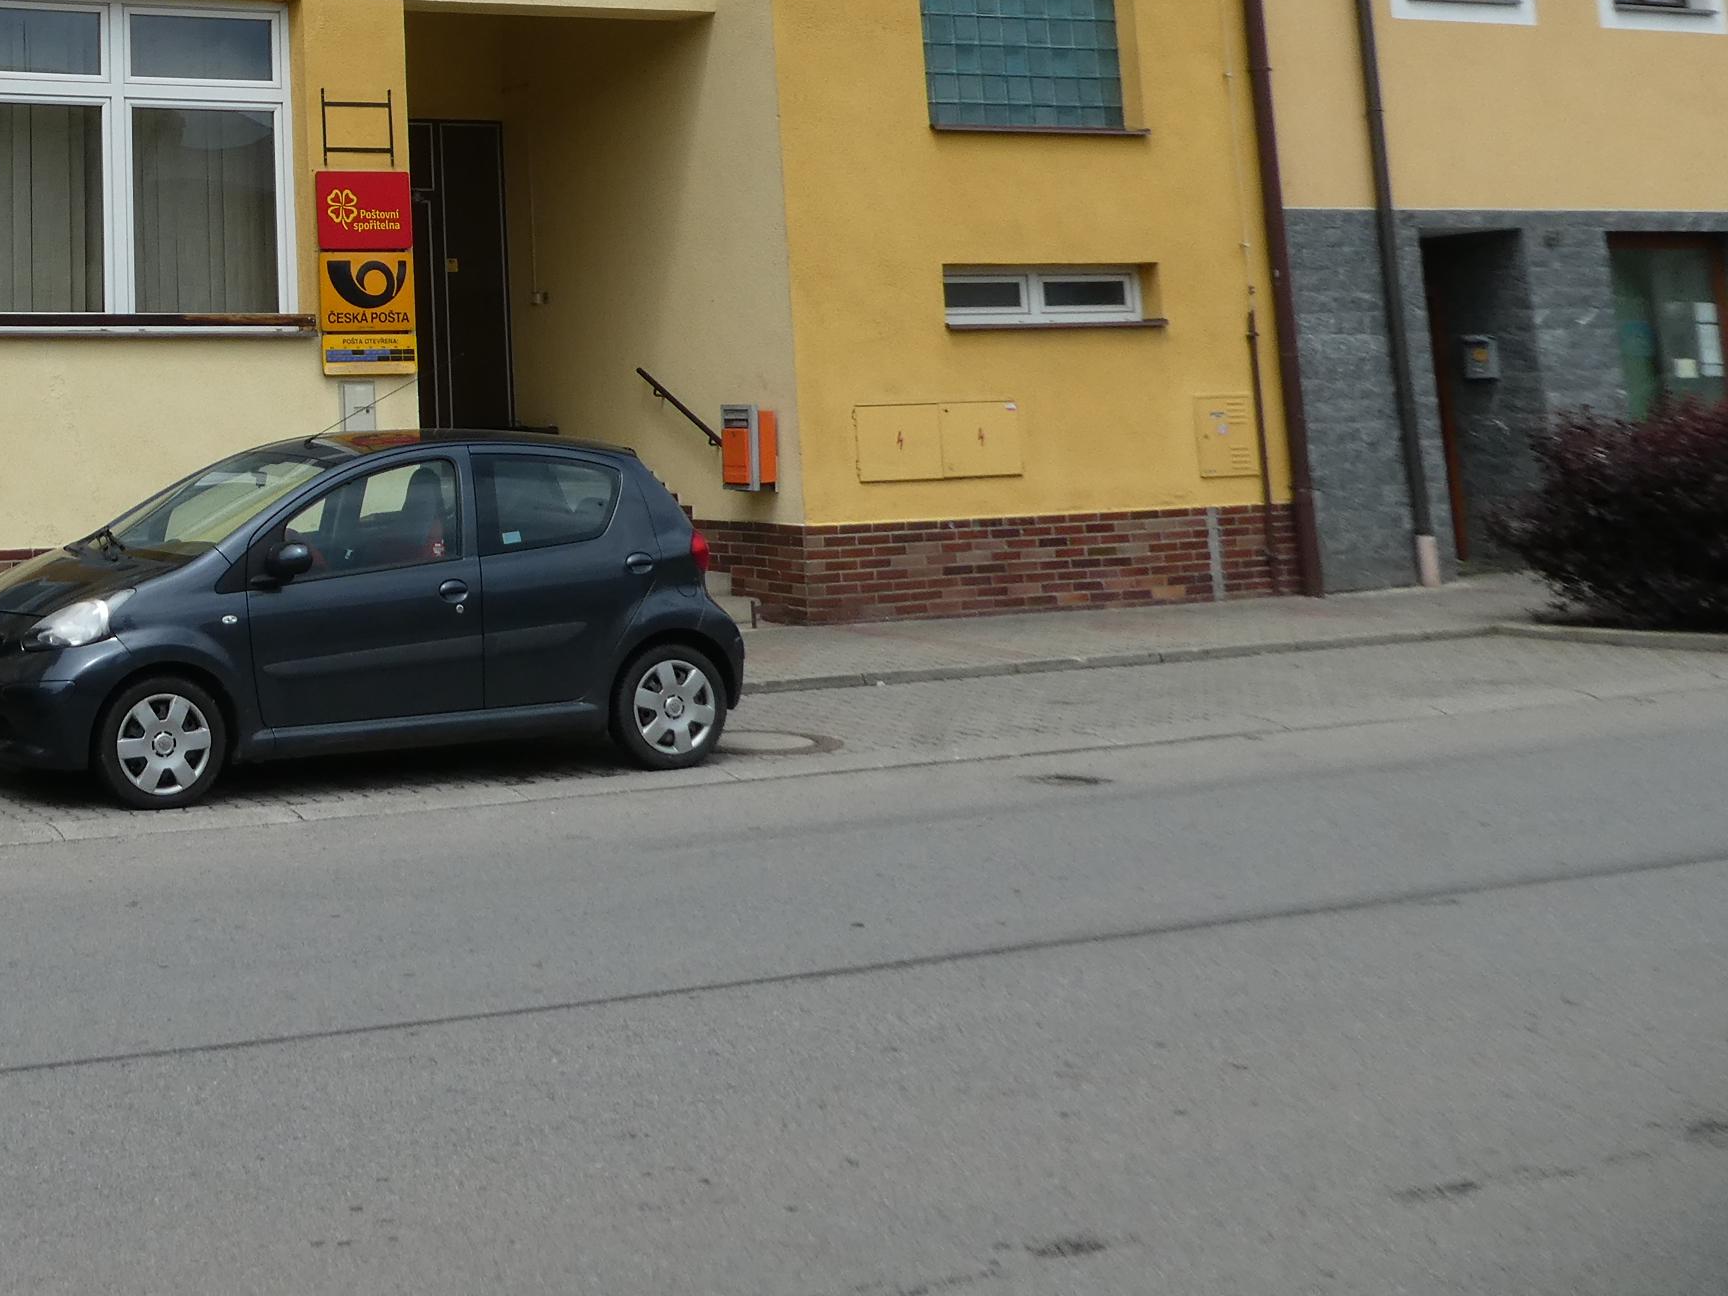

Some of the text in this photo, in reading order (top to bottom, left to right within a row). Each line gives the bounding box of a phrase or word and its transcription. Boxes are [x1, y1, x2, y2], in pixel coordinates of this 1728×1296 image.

[360, 209, 399, 219] Poštovní
[353, 220, 400, 232] spořitelna
[328, 310, 410, 324] ČESKÁ POŠTA
